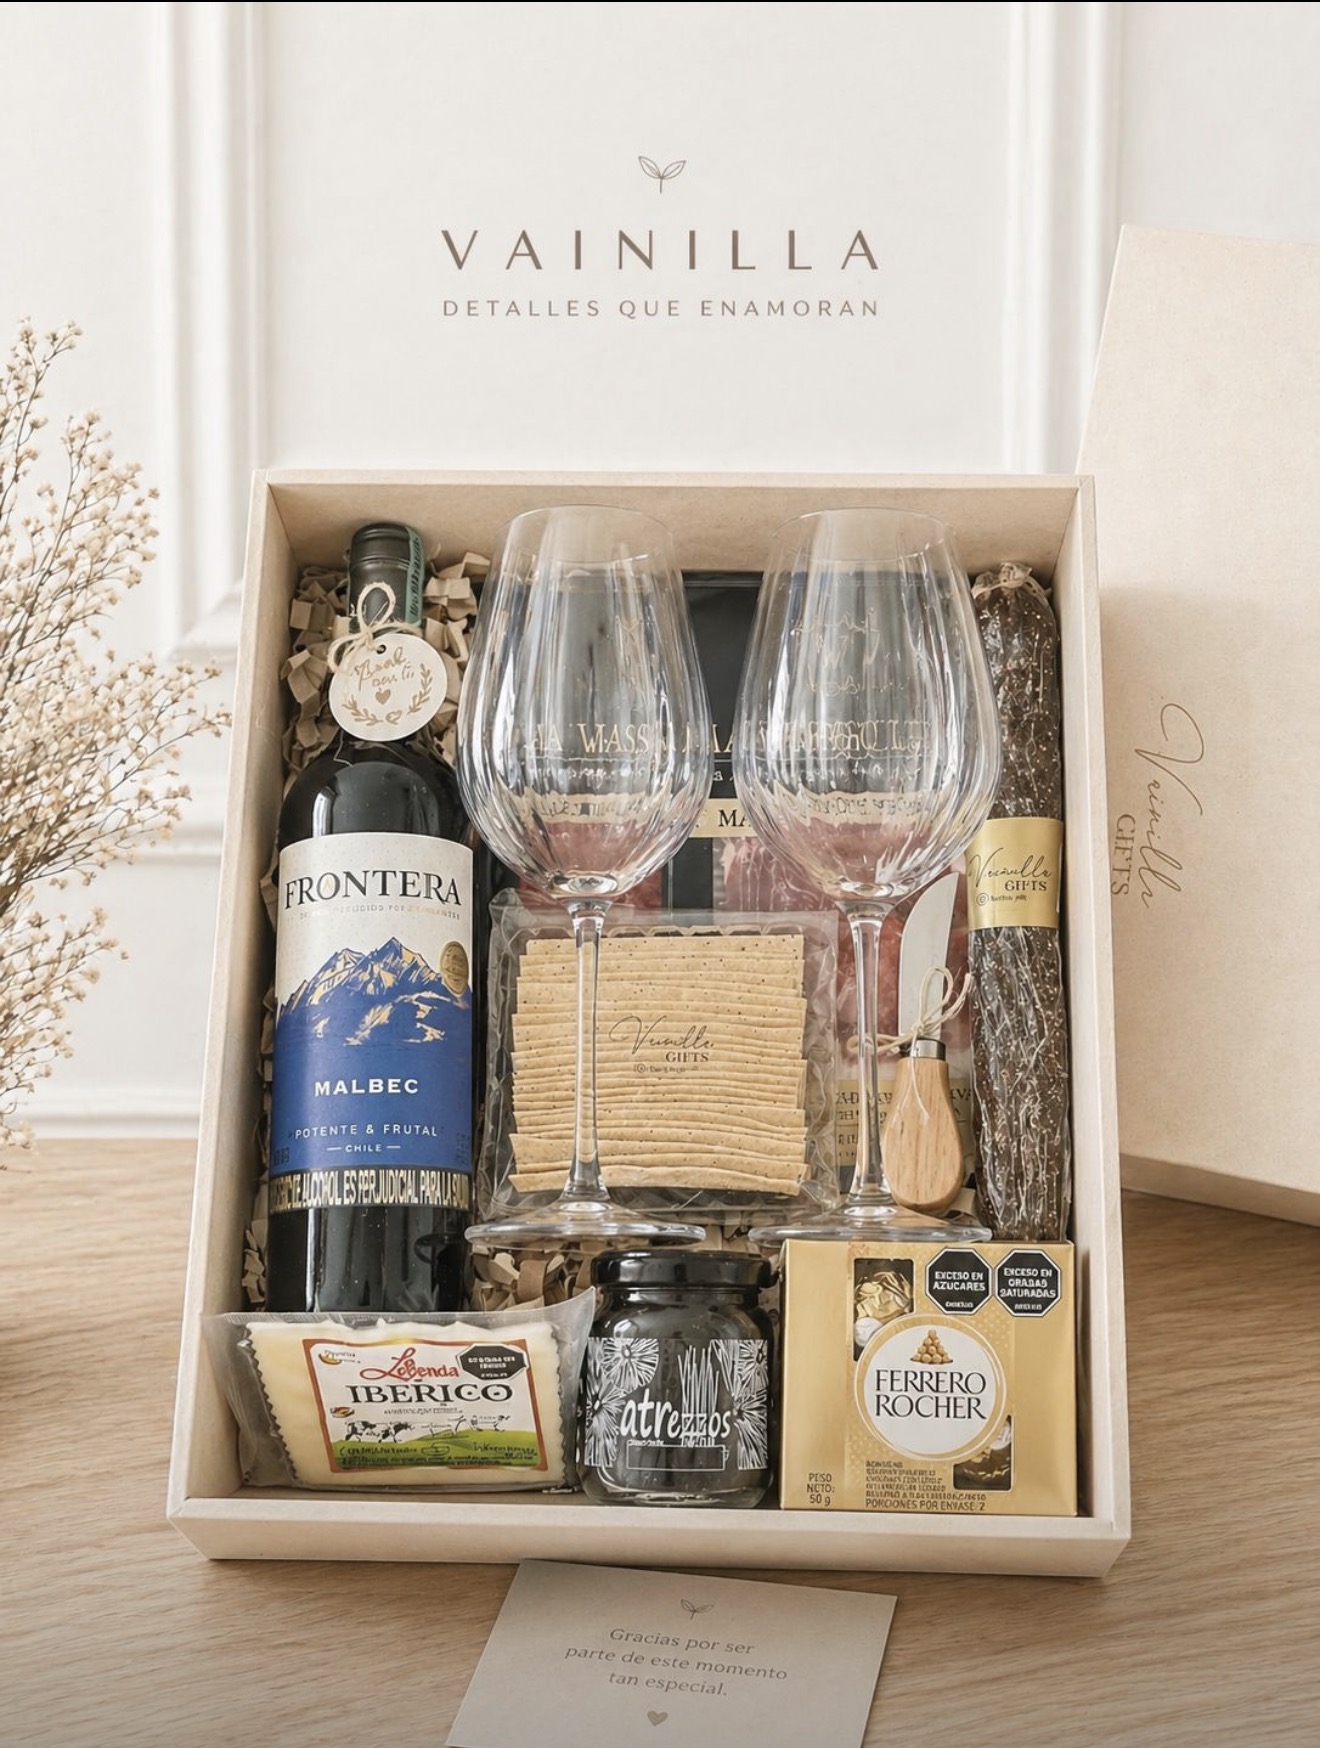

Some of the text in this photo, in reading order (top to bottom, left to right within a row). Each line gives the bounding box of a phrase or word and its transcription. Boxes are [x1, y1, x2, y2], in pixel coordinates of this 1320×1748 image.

[441, 230, 879, 270] VAINILLA
[443, 300, 878, 320] DETALLES QUE ENAMORAN
[285, 870, 462, 910] FRONTERA
[314, 1078, 419, 1097] MALBEC
[294, 1123, 438, 1140] POTENTE & FRUTAL
[344, 1144, 382, 1153] CHILE
[875, 1369, 987, 1394] FERRERO
[875, 1395, 987, 1419] ROCHER
[808, 1473, 832, 1483] PESO
[809, 1494, 823, 1504] 50
[979, 1502, 986, 1511] 2
[609, 1628, 755, 1655] Gracias por ser
[564, 1647, 788, 1680] parte de este momento
[608, 1671, 728, 1697] tan especial.
